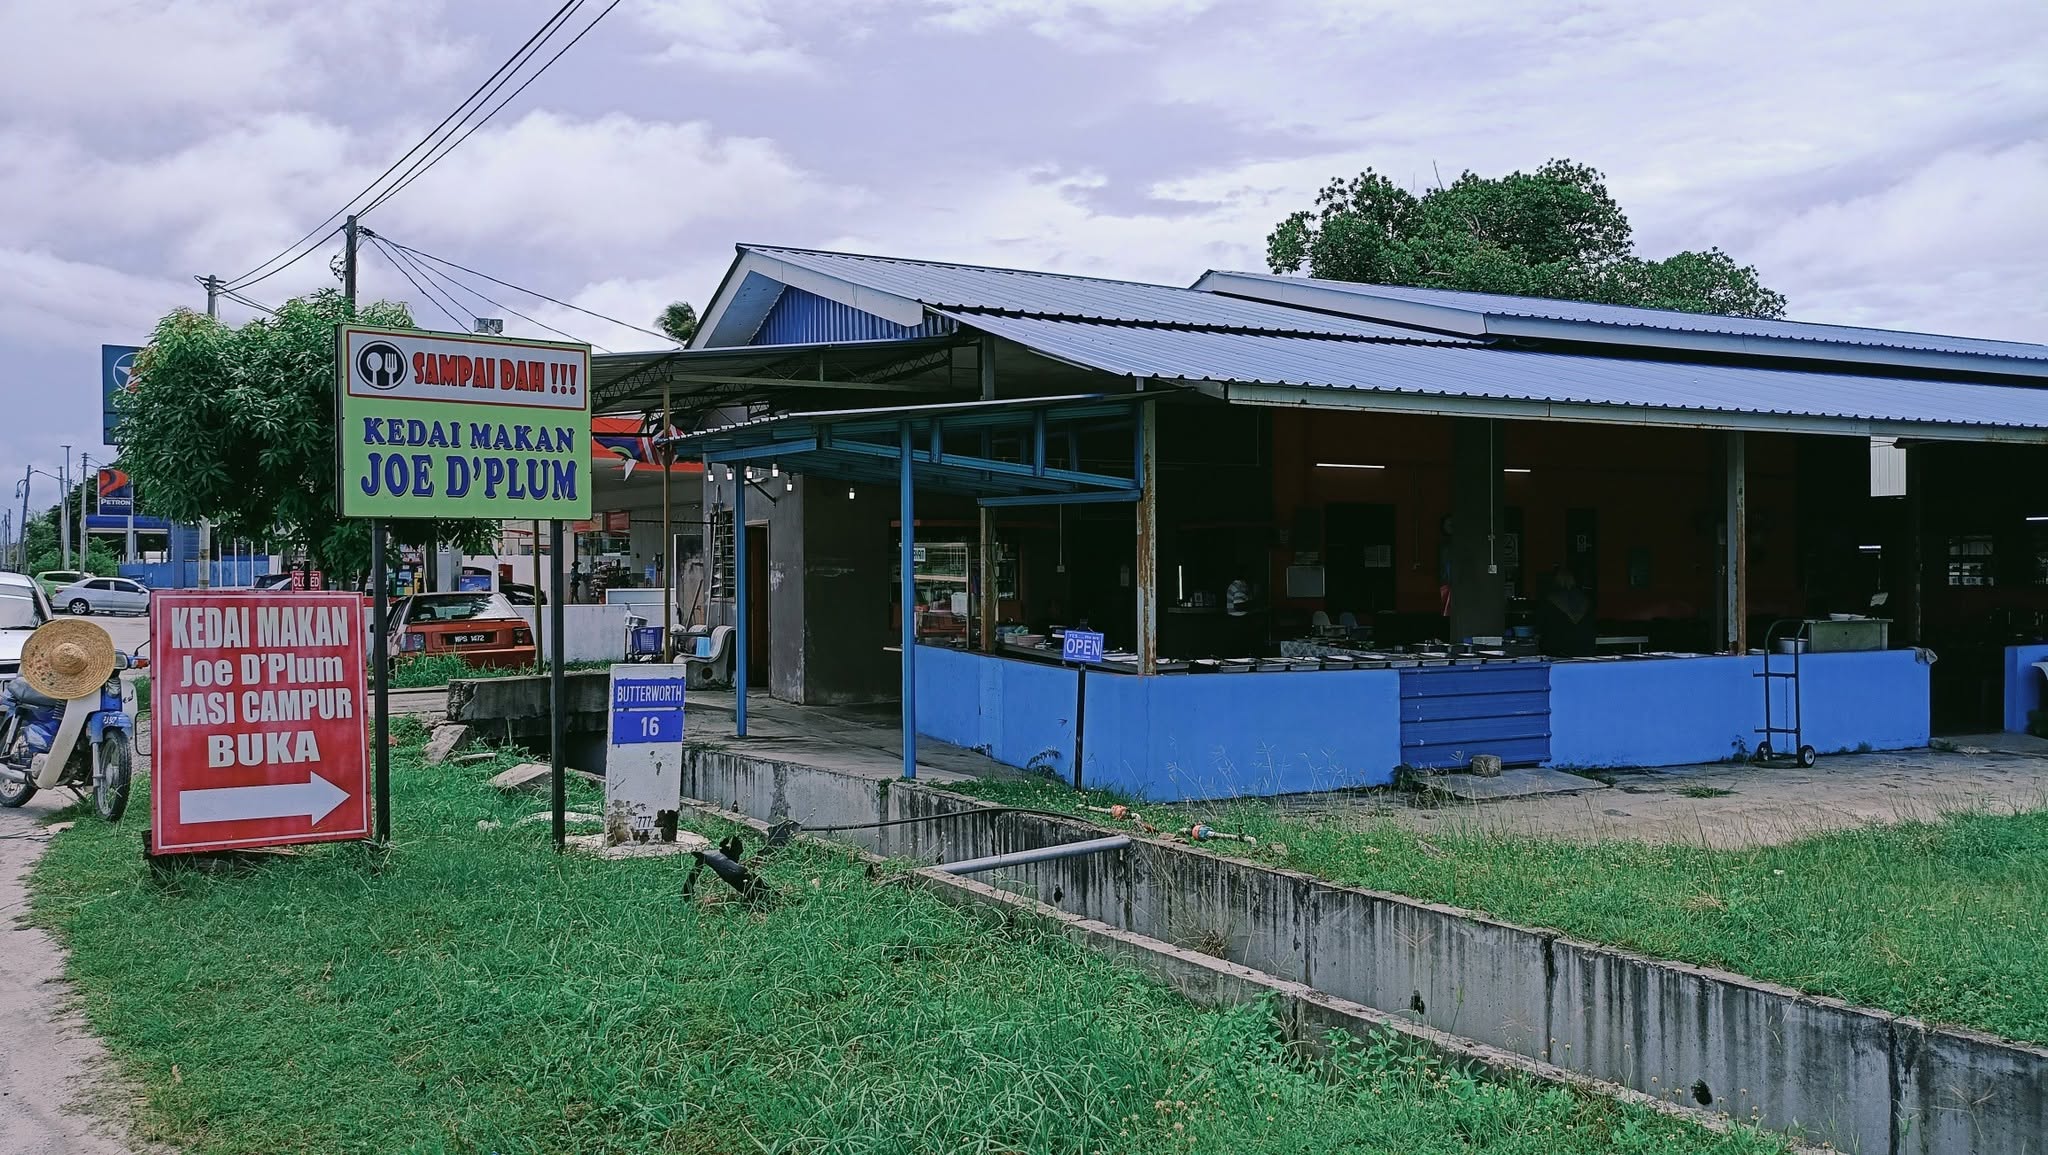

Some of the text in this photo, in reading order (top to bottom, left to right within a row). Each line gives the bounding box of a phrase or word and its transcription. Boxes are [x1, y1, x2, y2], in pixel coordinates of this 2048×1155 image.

[412, 352, 577, 395] SAMPAI DAH !!!
[363, 417, 575, 453] KEDAI MAKAN
[361, 453, 577, 500] JOE D'PLUM
[100, 498, 131, 506] PETRON
[171, 606, 349, 648] KEDAI MAKAN
[1066, 638, 1101, 656] OPEN
[180, 653, 344, 687] Joe D'Plum
[171, 688, 353, 726] NASI CAMPUR
[616, 685, 682, 702] BUTTERWORTH
[641, 716, 660, 737] 16
[207, 730, 321, 768] BUKA
